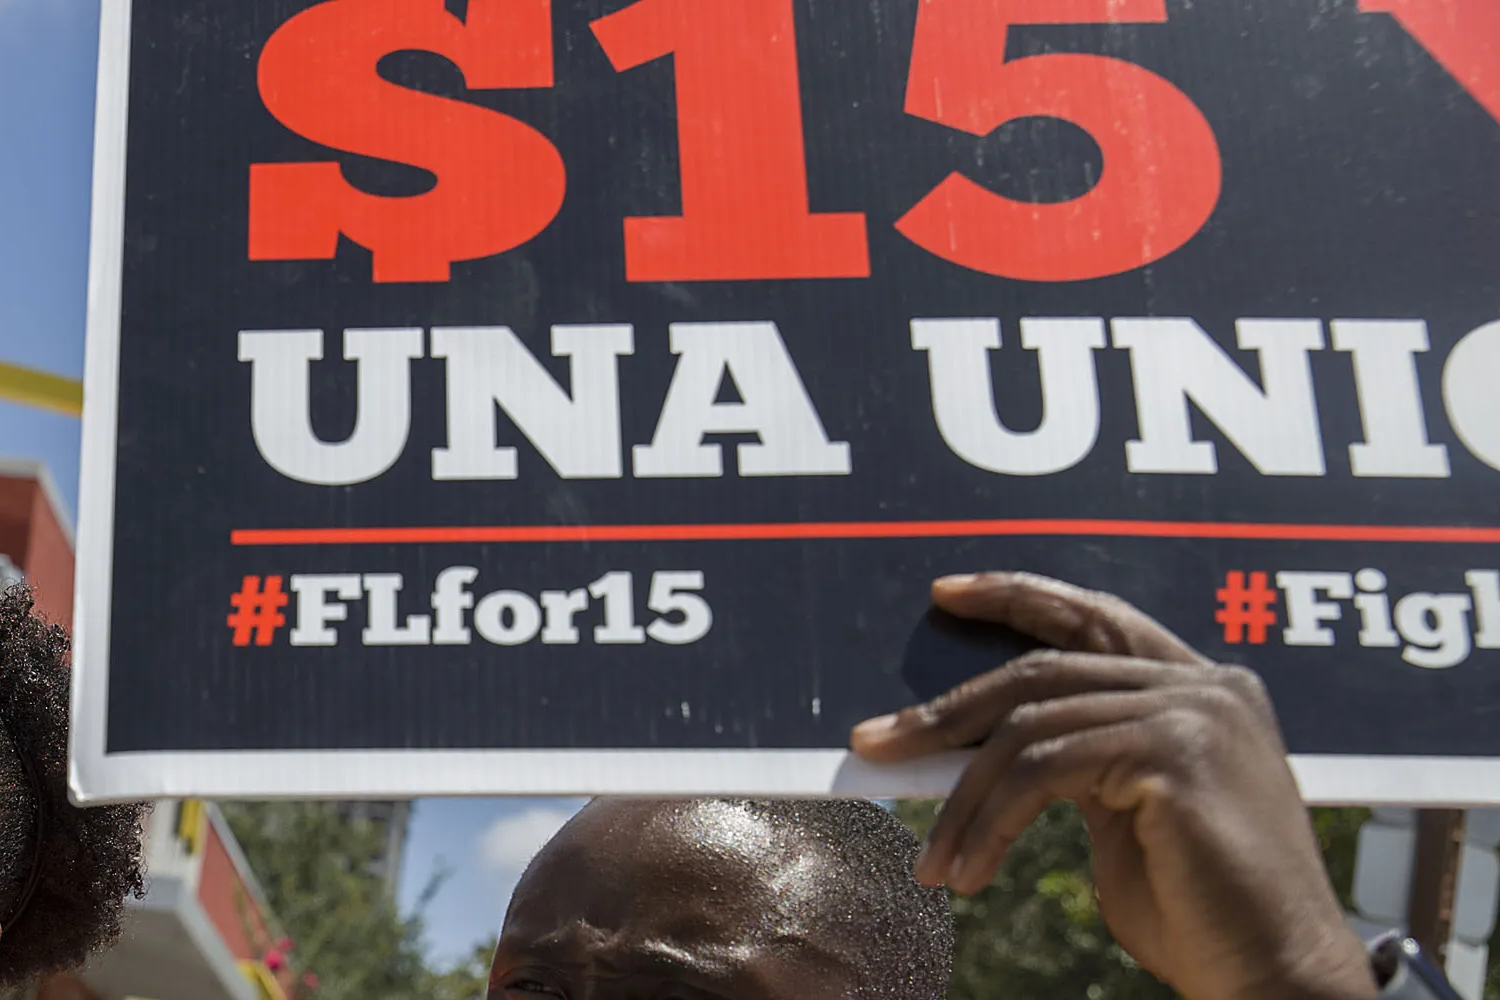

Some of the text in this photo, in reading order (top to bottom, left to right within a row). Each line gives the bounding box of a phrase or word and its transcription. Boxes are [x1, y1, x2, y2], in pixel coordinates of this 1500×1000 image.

[248, 0, 1222, 283] $15
[237, 321, 852, 485] UNA
[227, 567, 712, 646] #FLfor15
